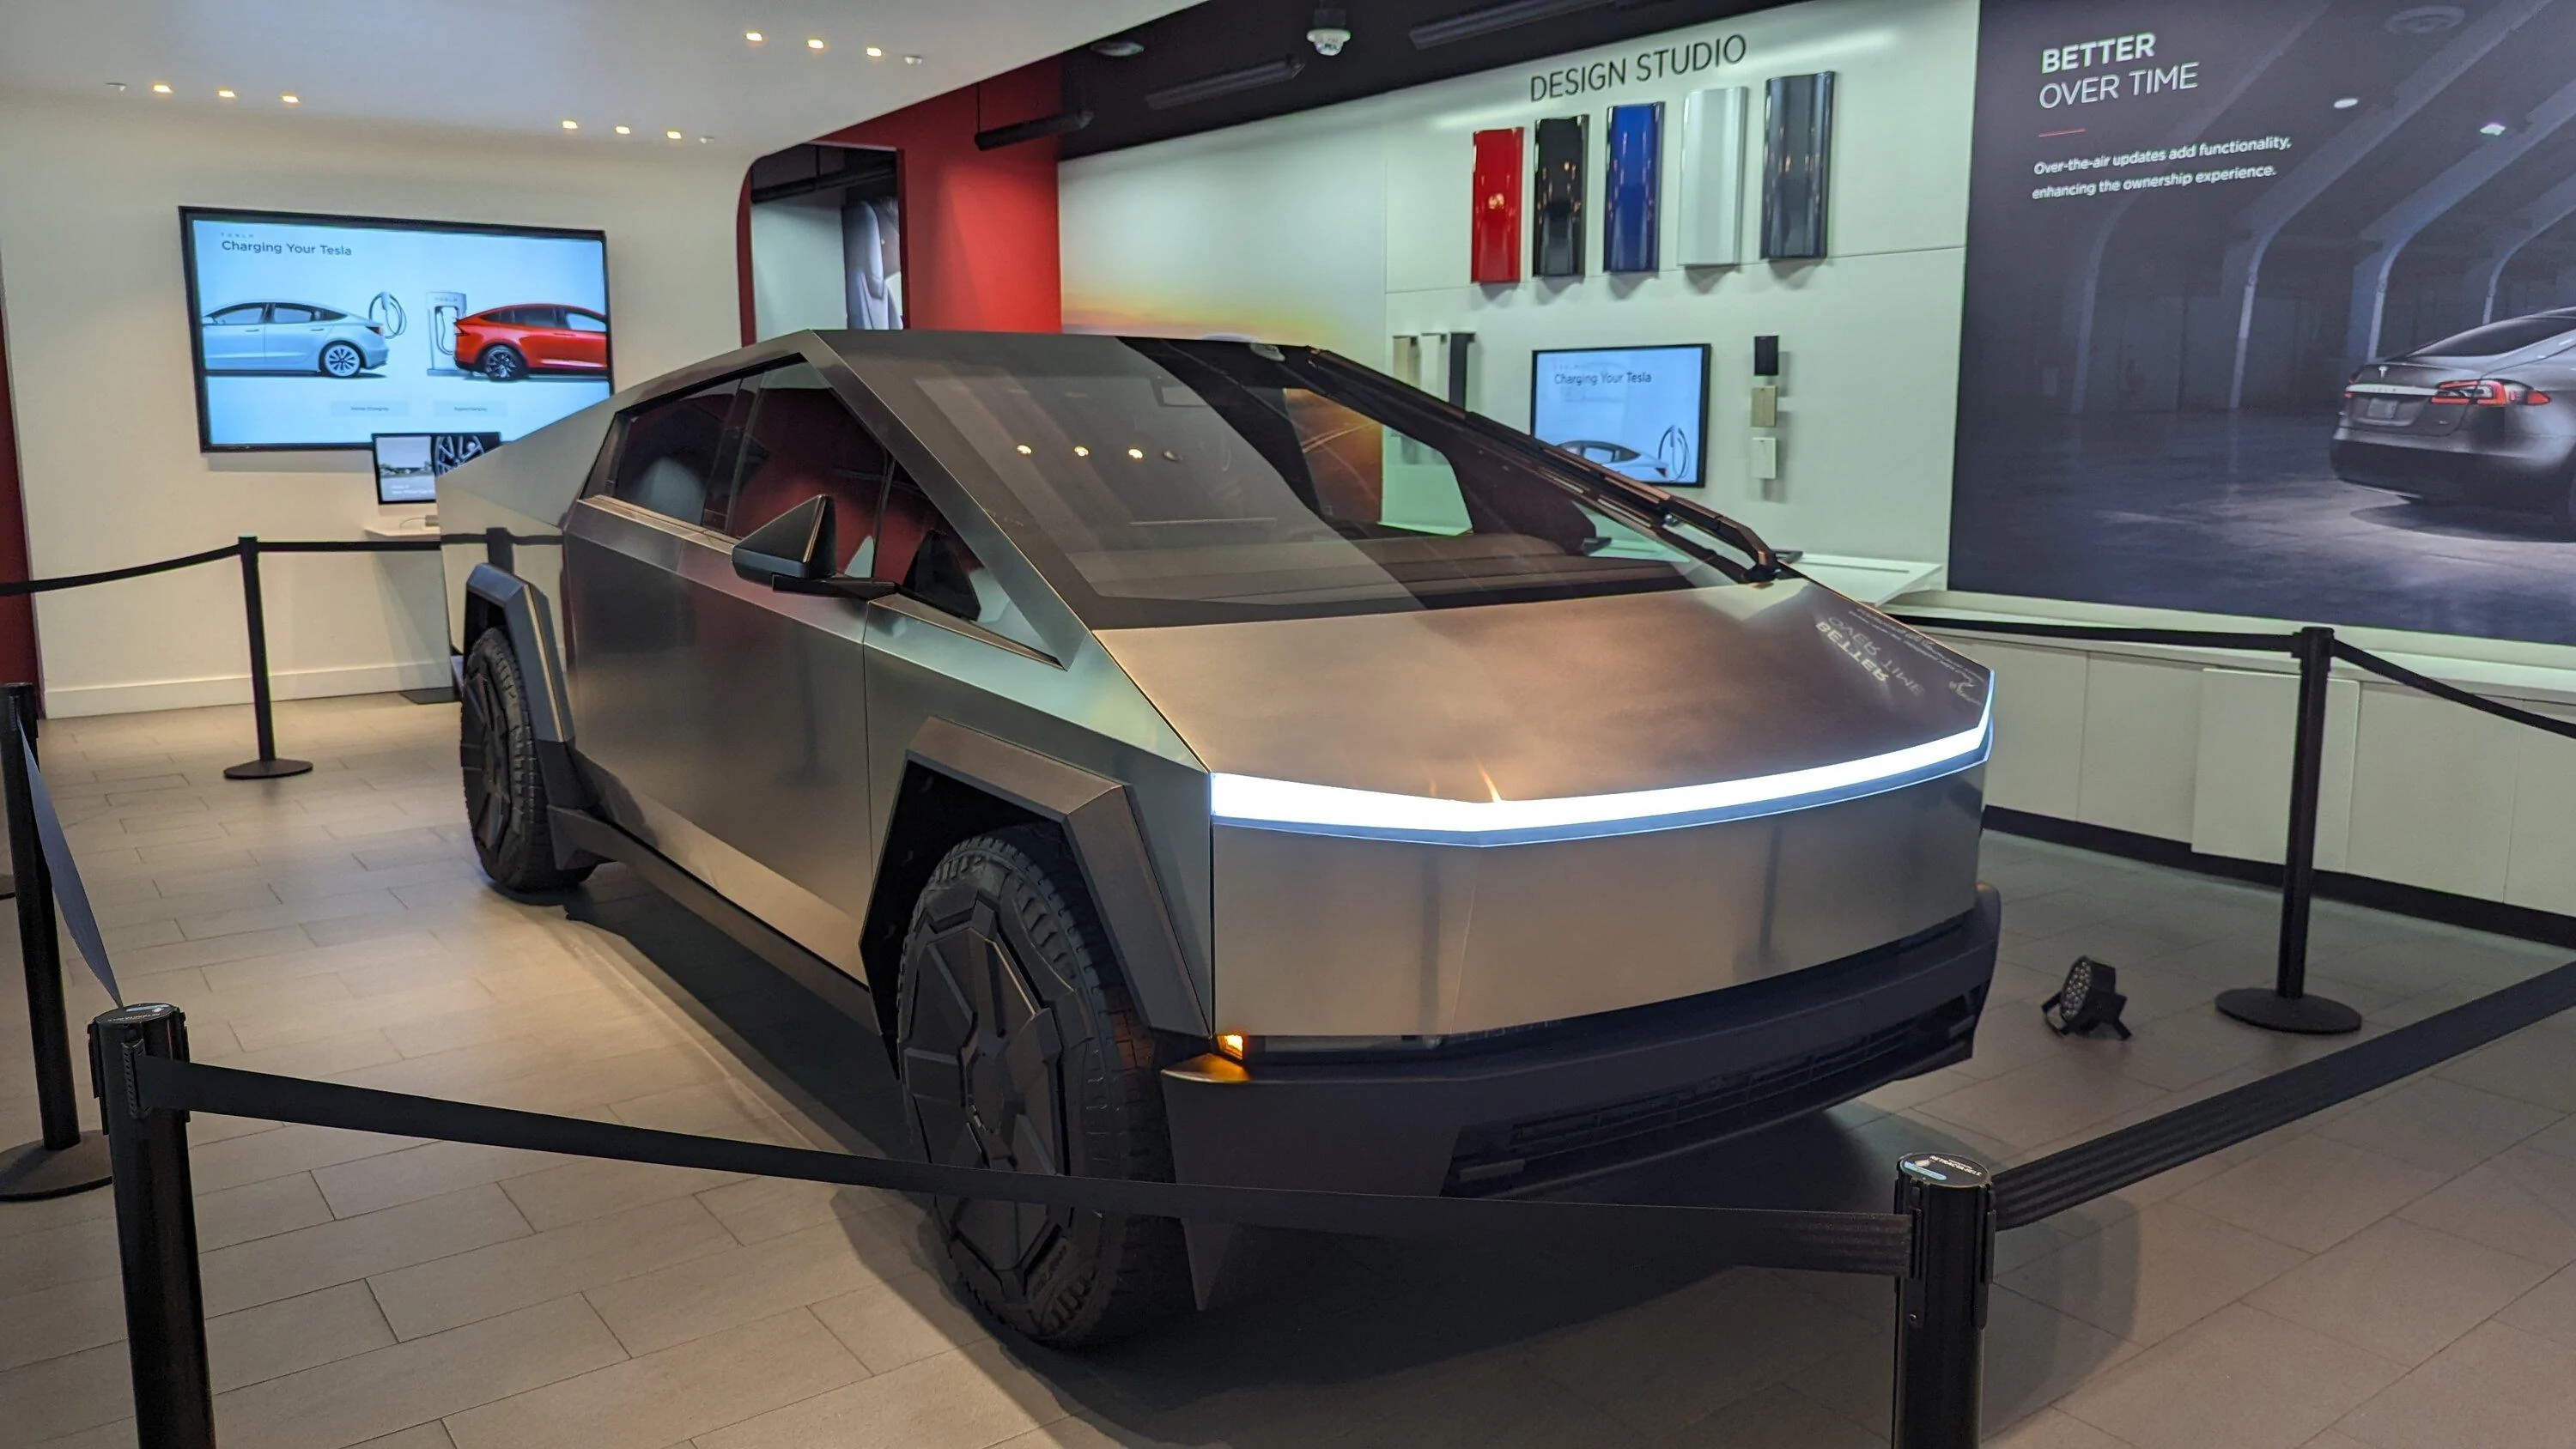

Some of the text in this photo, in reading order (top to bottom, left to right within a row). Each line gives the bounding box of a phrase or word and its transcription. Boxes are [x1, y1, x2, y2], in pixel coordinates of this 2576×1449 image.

[1531, 34, 1747, 101] DESIGN STUDIO
[2041, 32, 2156, 74] BETTER
[2038, 61, 2200, 109] OVER TIME
[2033, 155, 2111, 175] Over-the-air
[2112, 149, 2166, 167] updates
[2168, 144, 2197, 161] add
[2032, 165, 2277, 199] enhancing the ownership experience.
[222, 239, 352, 256] Charging Your Tesla
[1554, 370, 1653, 386] Charging Your Tesla
